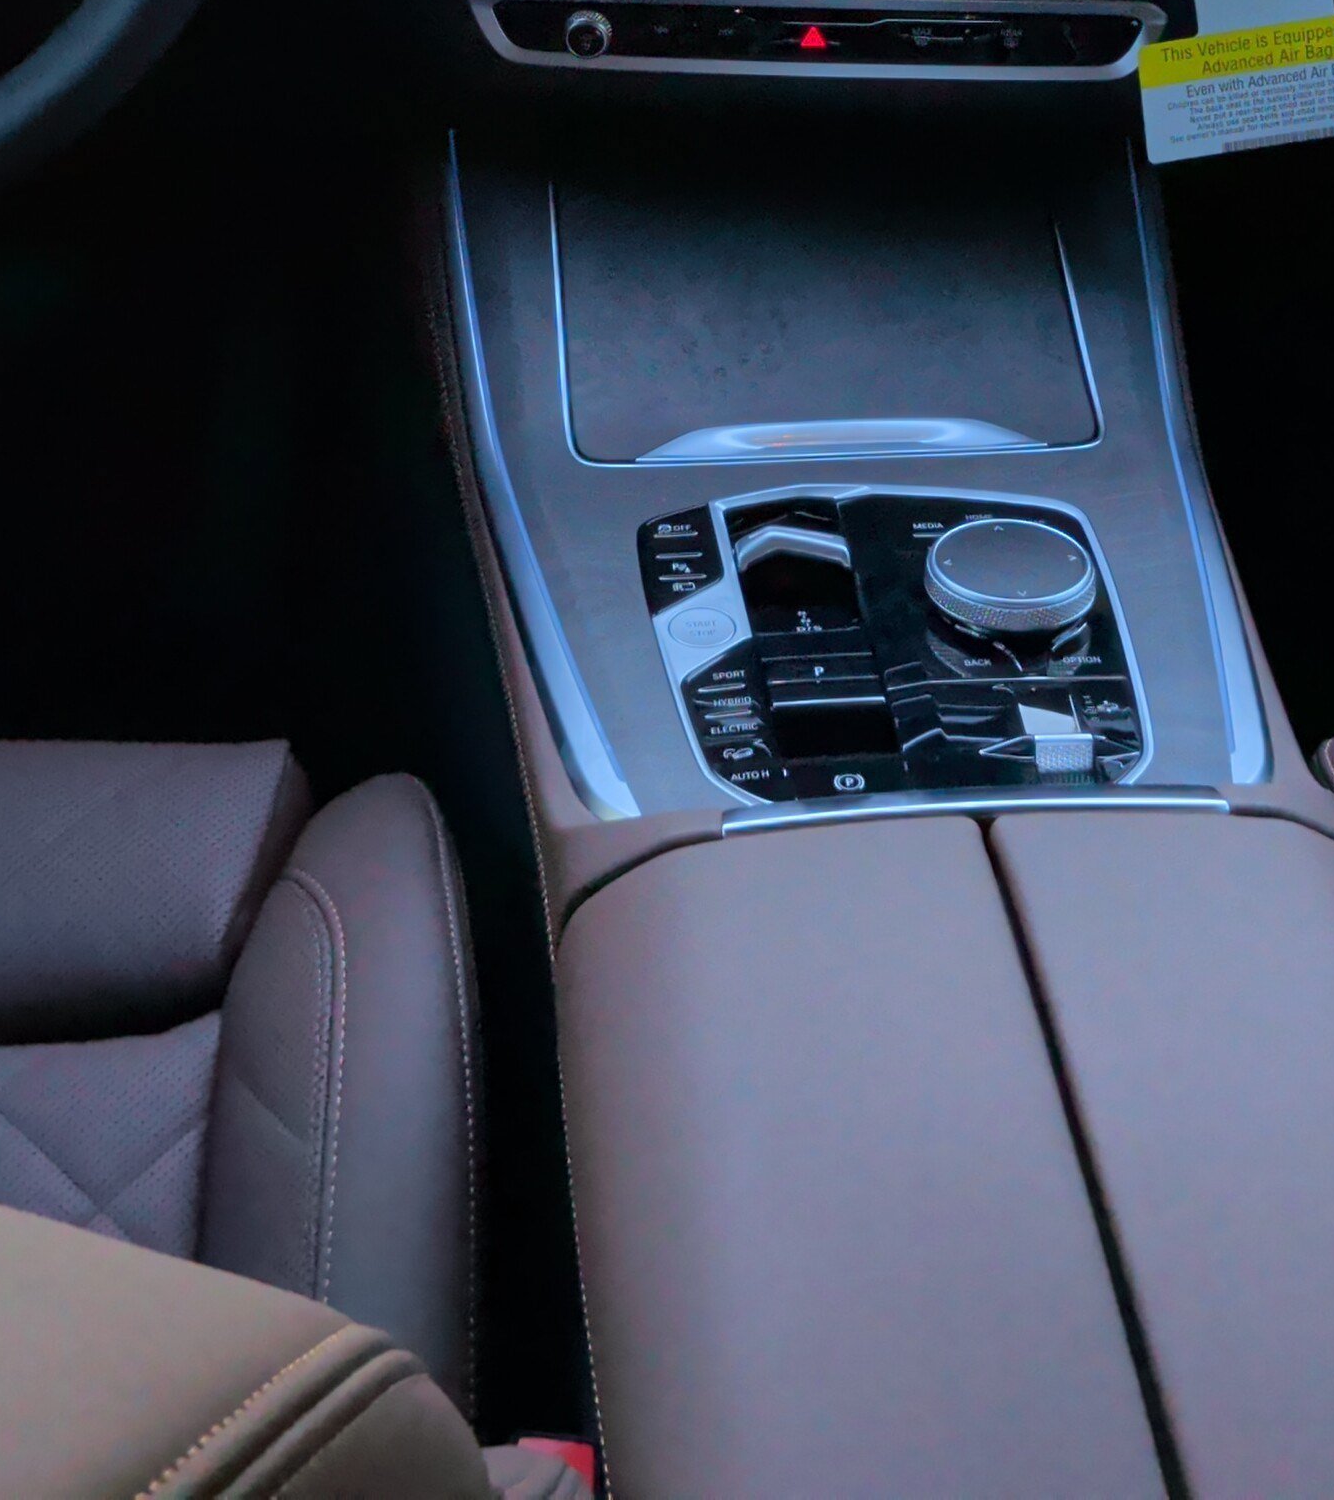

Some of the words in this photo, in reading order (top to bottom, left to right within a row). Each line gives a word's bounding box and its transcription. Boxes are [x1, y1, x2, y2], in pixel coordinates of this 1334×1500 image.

[1161, 47, 1192, 63] This
[1197, 37, 1251, 56] Vehicle
[1256, 35, 1268, 47] is
[1202, 55, 1274, 75] Advanced
[1280, 49, 1299, 63] Air
[1186, 84, 1215, 98] Even
[1218, 78, 1244, 93] with
[1248, 70, 1306, 89] Advanced
[1311, 66, 1328, 79] Air
[912, 522, 944, 530] MEDIA
[686, 620, 716, 628] START
[689, 629, 716, 637] STOP
[964, 658, 992, 667] BACK
[1062, 656, 1102, 665] OPTION
[712, 669, 745, 681] SPORT
[814, 665, 825, 677] P
[713, 696, 752, 707] HYBRID
[710, 723, 759, 735] ELECTRIC
[731, 771, 760, 781] AUTO
